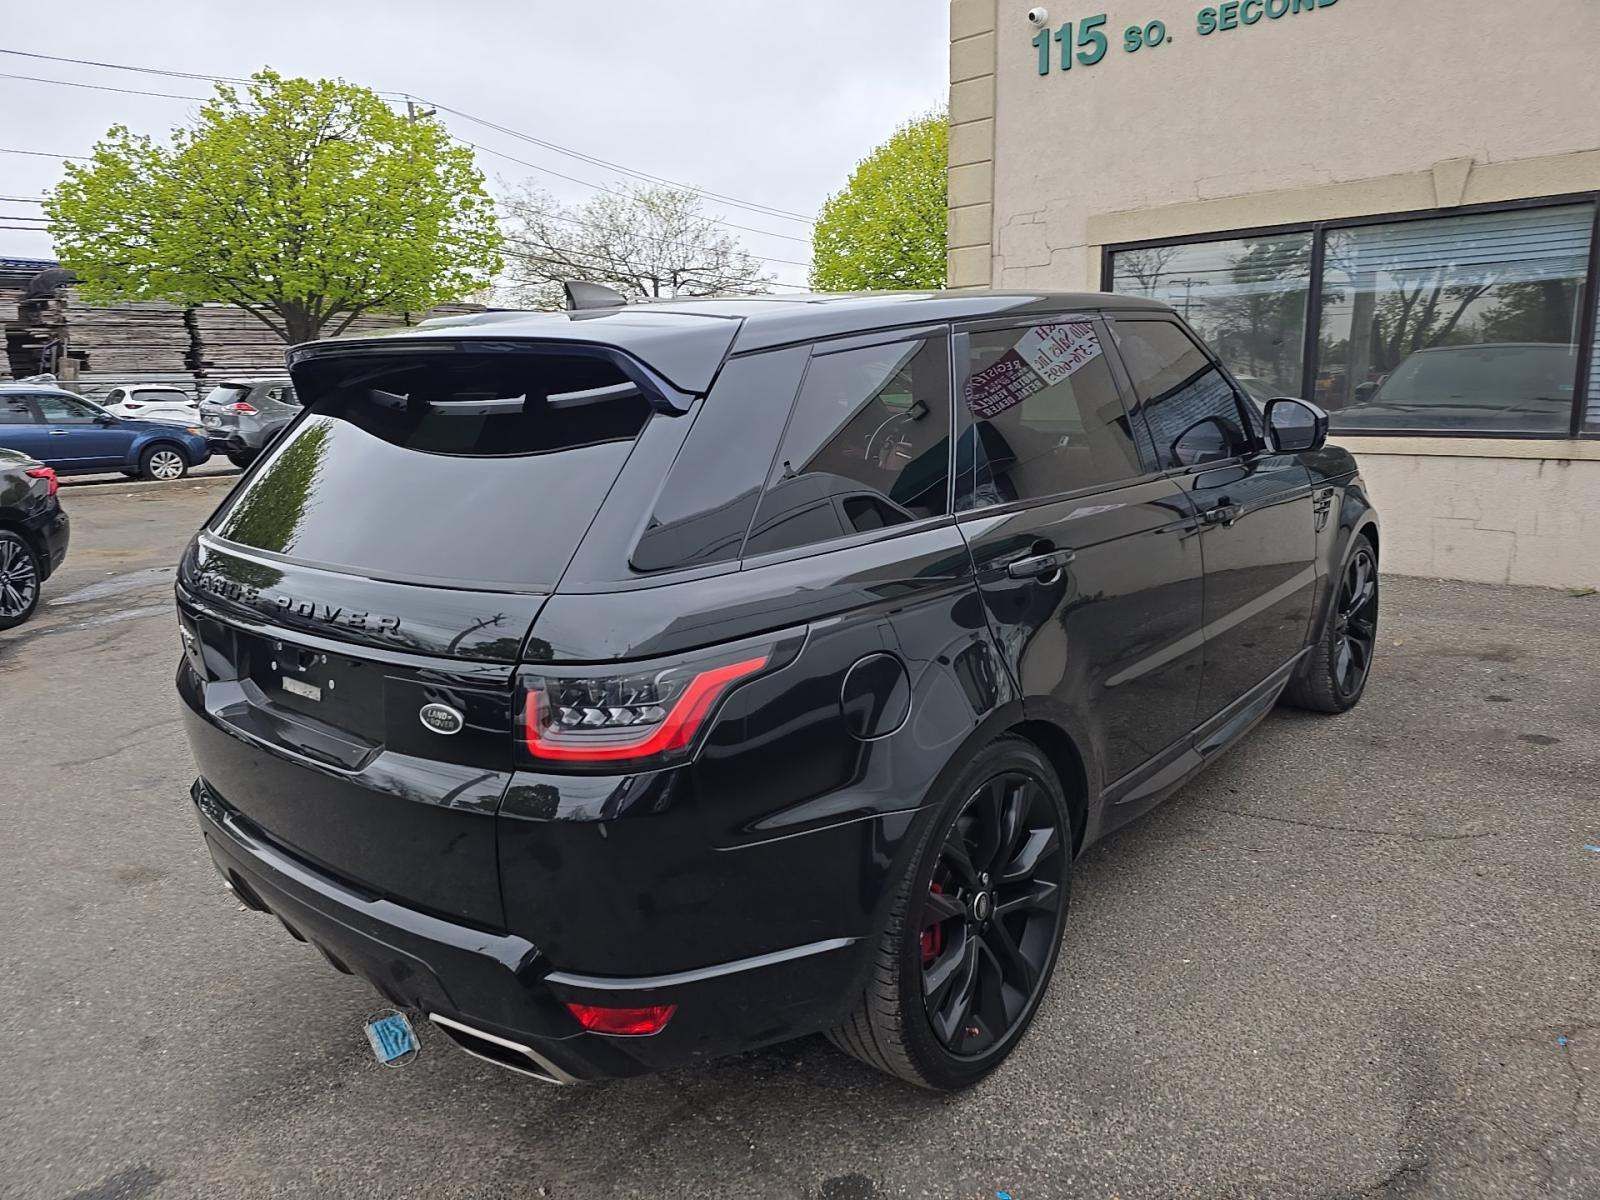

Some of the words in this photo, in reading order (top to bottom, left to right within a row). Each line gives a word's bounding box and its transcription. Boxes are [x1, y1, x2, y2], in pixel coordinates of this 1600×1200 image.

[1032, 13, 1108, 76] 115
[1123, 19, 1172, 53] SO.
[275, 594, 401, 635] ROVER
